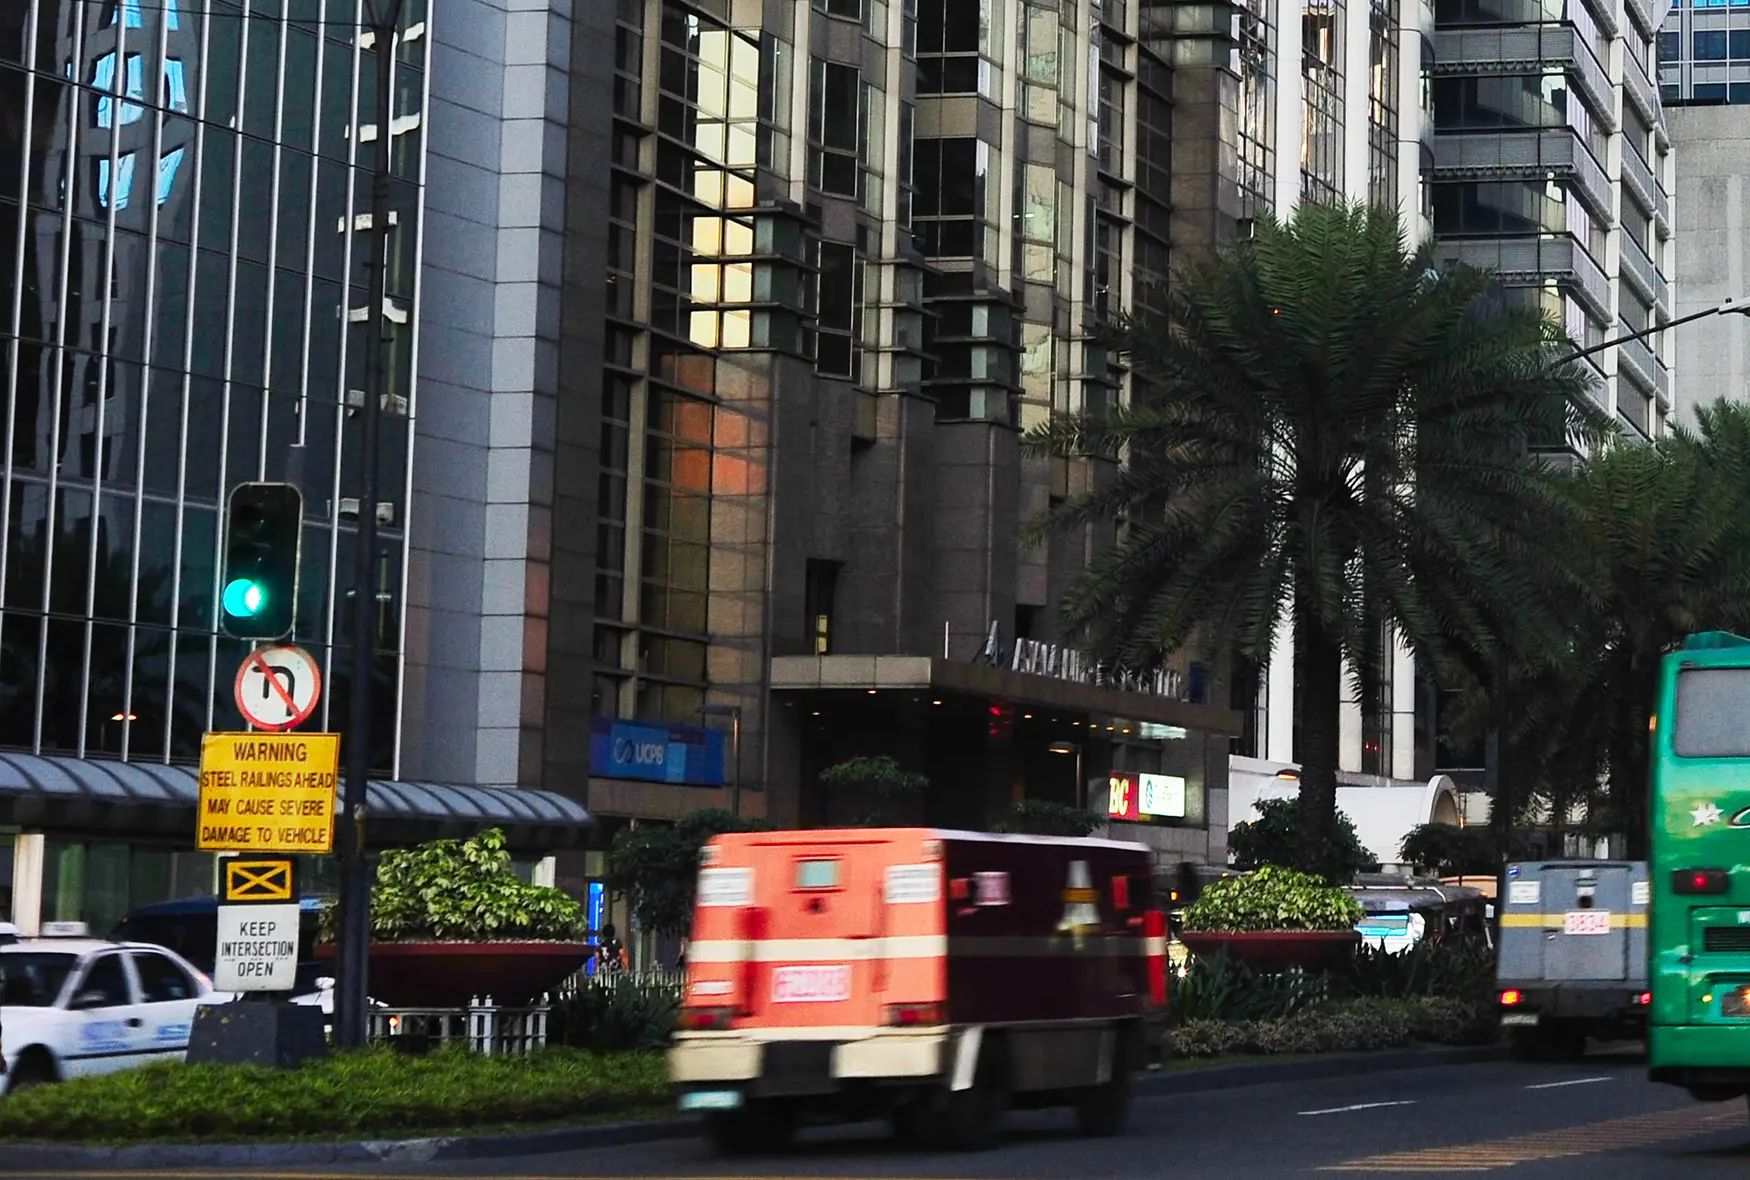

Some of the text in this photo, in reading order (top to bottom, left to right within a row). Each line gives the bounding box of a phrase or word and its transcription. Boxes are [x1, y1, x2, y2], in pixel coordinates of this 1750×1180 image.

[233, 742, 307, 762] WARNING
[635, 743, 664, 765] UCPB
[202, 771, 333, 789] STEEL RAILINGS AHEAD
[207, 798, 325, 816] MAY CAUSE SEVERE
[202, 826, 326, 844] DAMAGE TO VEHICLE
[240, 921, 276, 936] KEEP
[221, 941, 294, 956] INTERSECTION
[238, 961, 274, 977] OPEN
